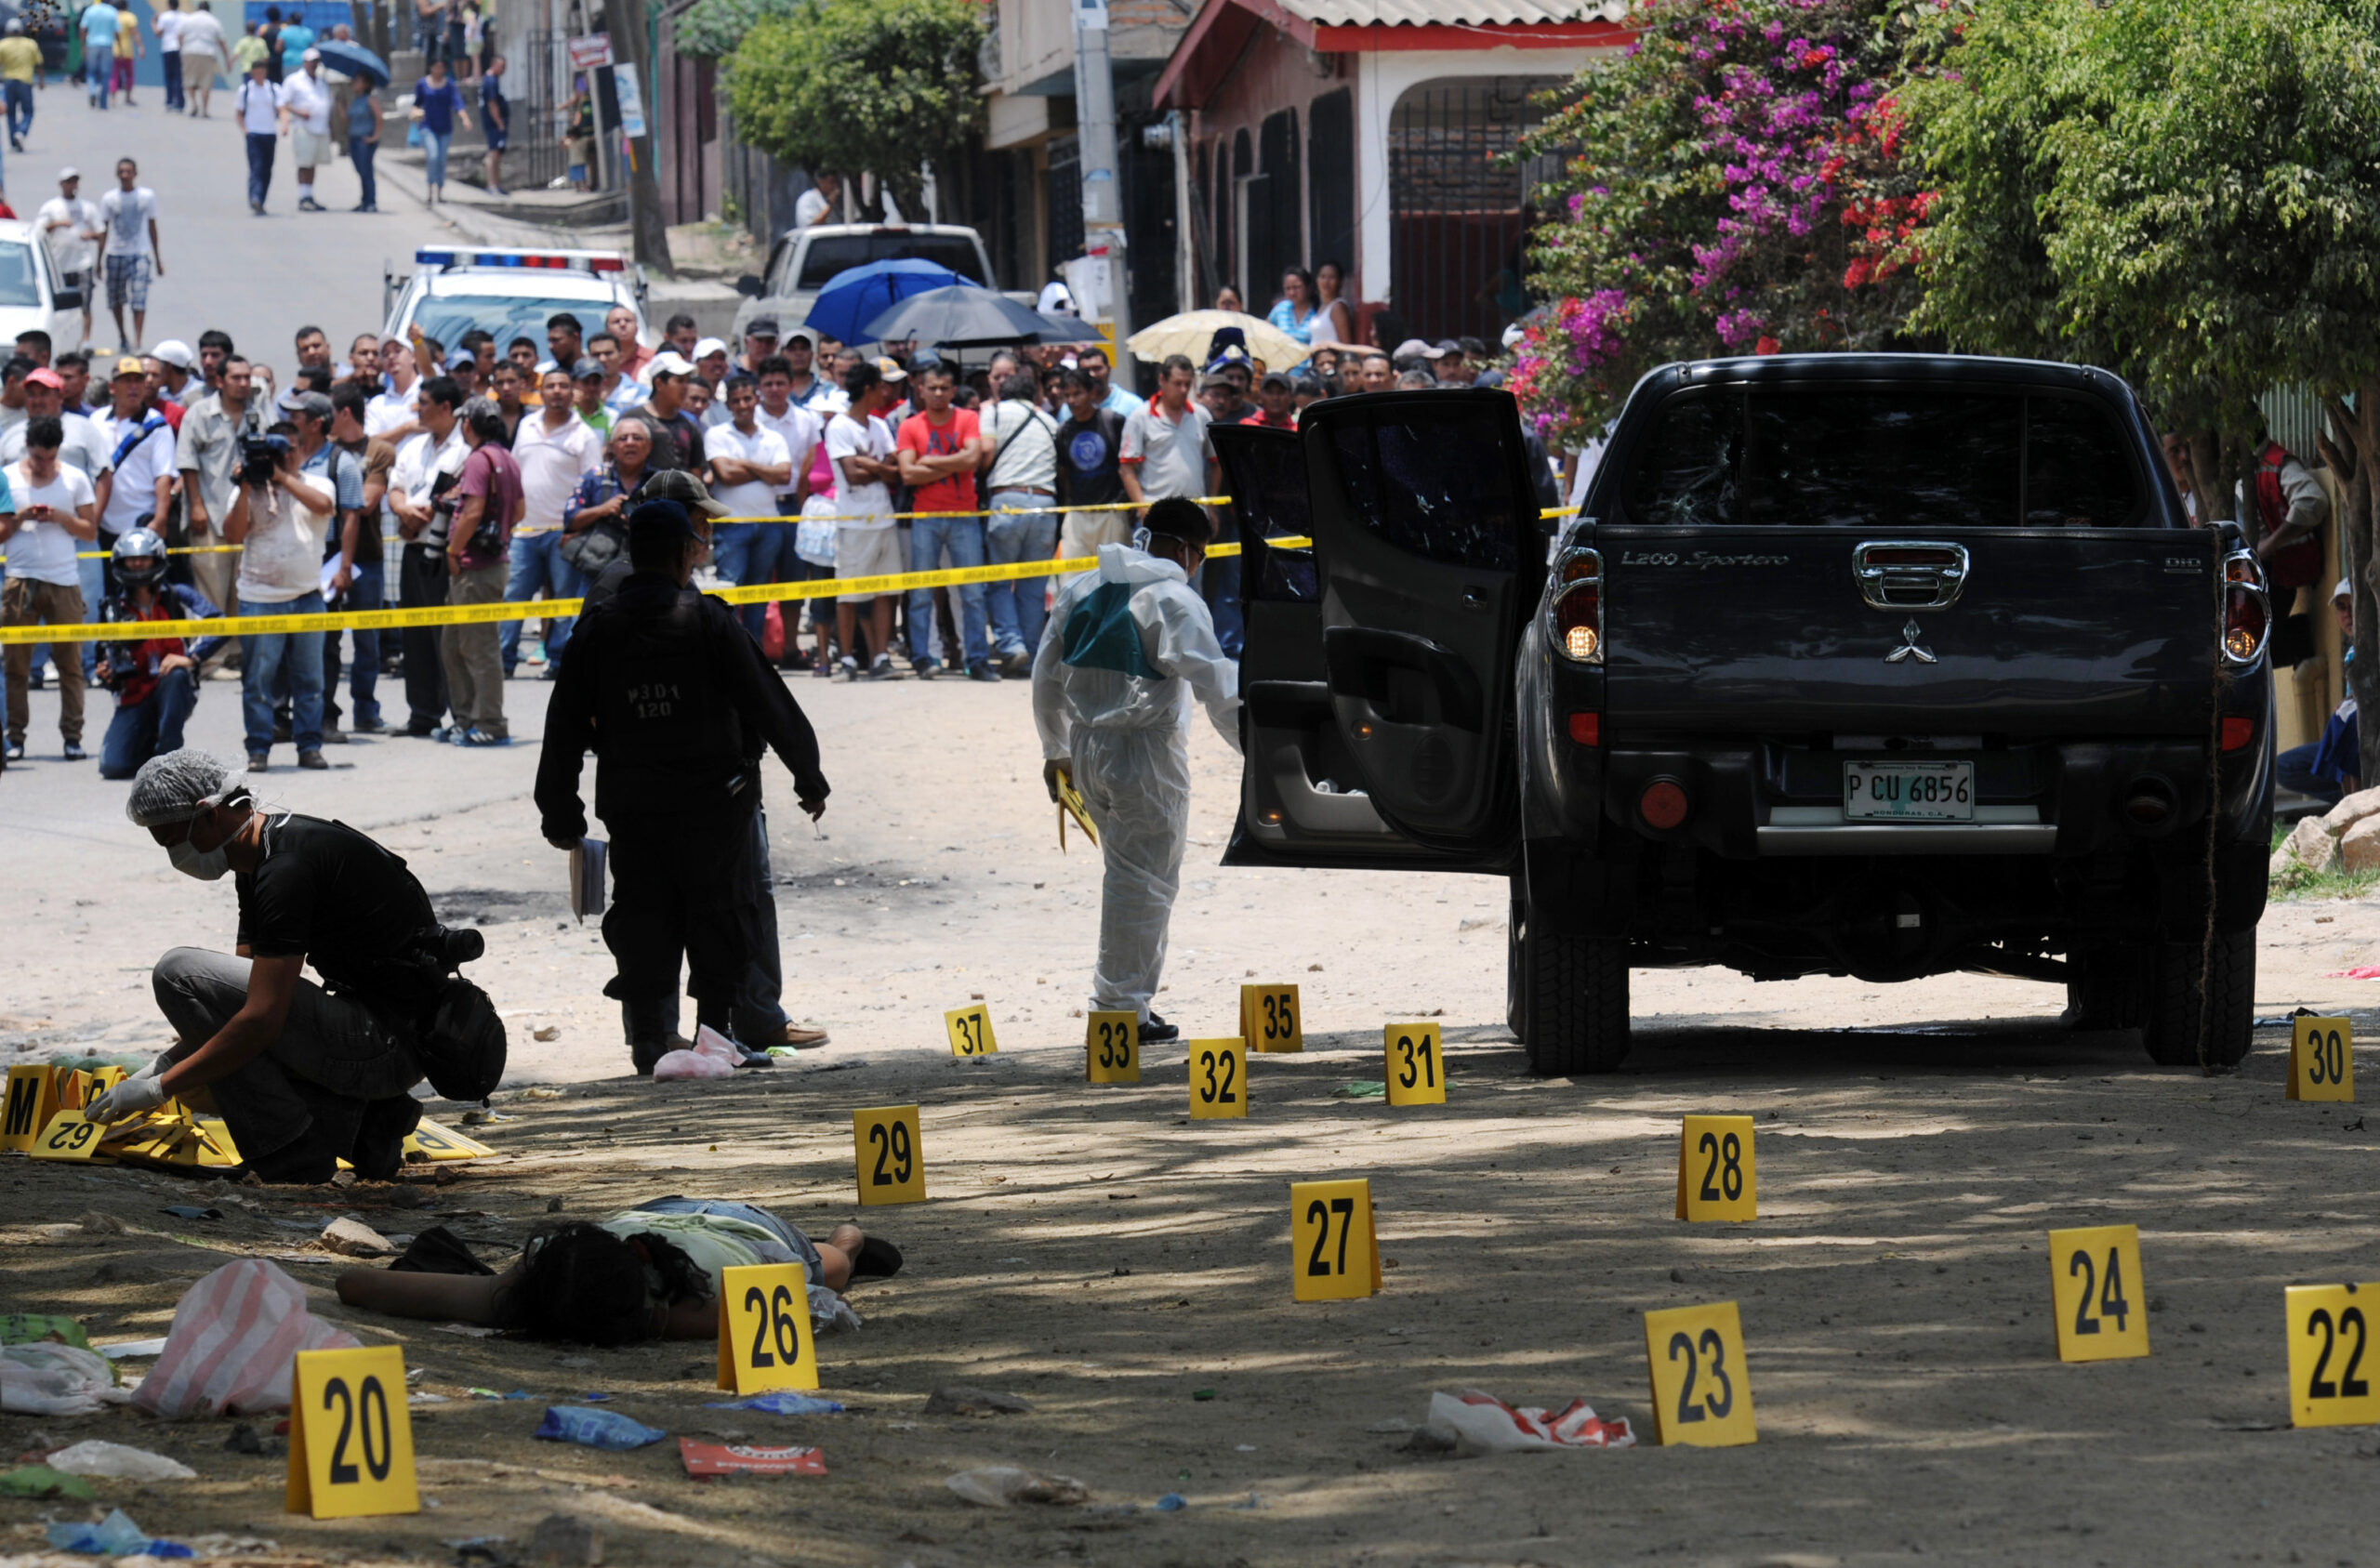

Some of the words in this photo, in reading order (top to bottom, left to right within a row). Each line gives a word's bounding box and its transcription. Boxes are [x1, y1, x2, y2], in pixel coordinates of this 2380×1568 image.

[1620, 551, 1678, 565] L200
[1849, 774, 1861, 800] P
[1871, 774, 1899, 801] CU
[1910, 775, 1968, 803] 6856
[956, 1013, 983, 1054] 37
[1099, 1022, 1130, 1069] 33
[1263, 995, 1292, 1039] 35
[1200, 1050, 1236, 1103] 32
[1397, 1034, 1434, 1088] 31
[2308, 1030, 2343, 1085] 30
[5, 1077, 39, 1136] M
[870, 1121, 911, 1186] 29
[1699, 1132, 1742, 1201] 28
[1307, 1198, 1354, 1276] 27
[2070, 1246, 2128, 1335] 24
[745, 1285, 798, 1367] 26
[2308, 1307, 2368, 1398] 22
[1669, 1328, 1732, 1423] 23
[324, 1376, 390, 1484] 20
